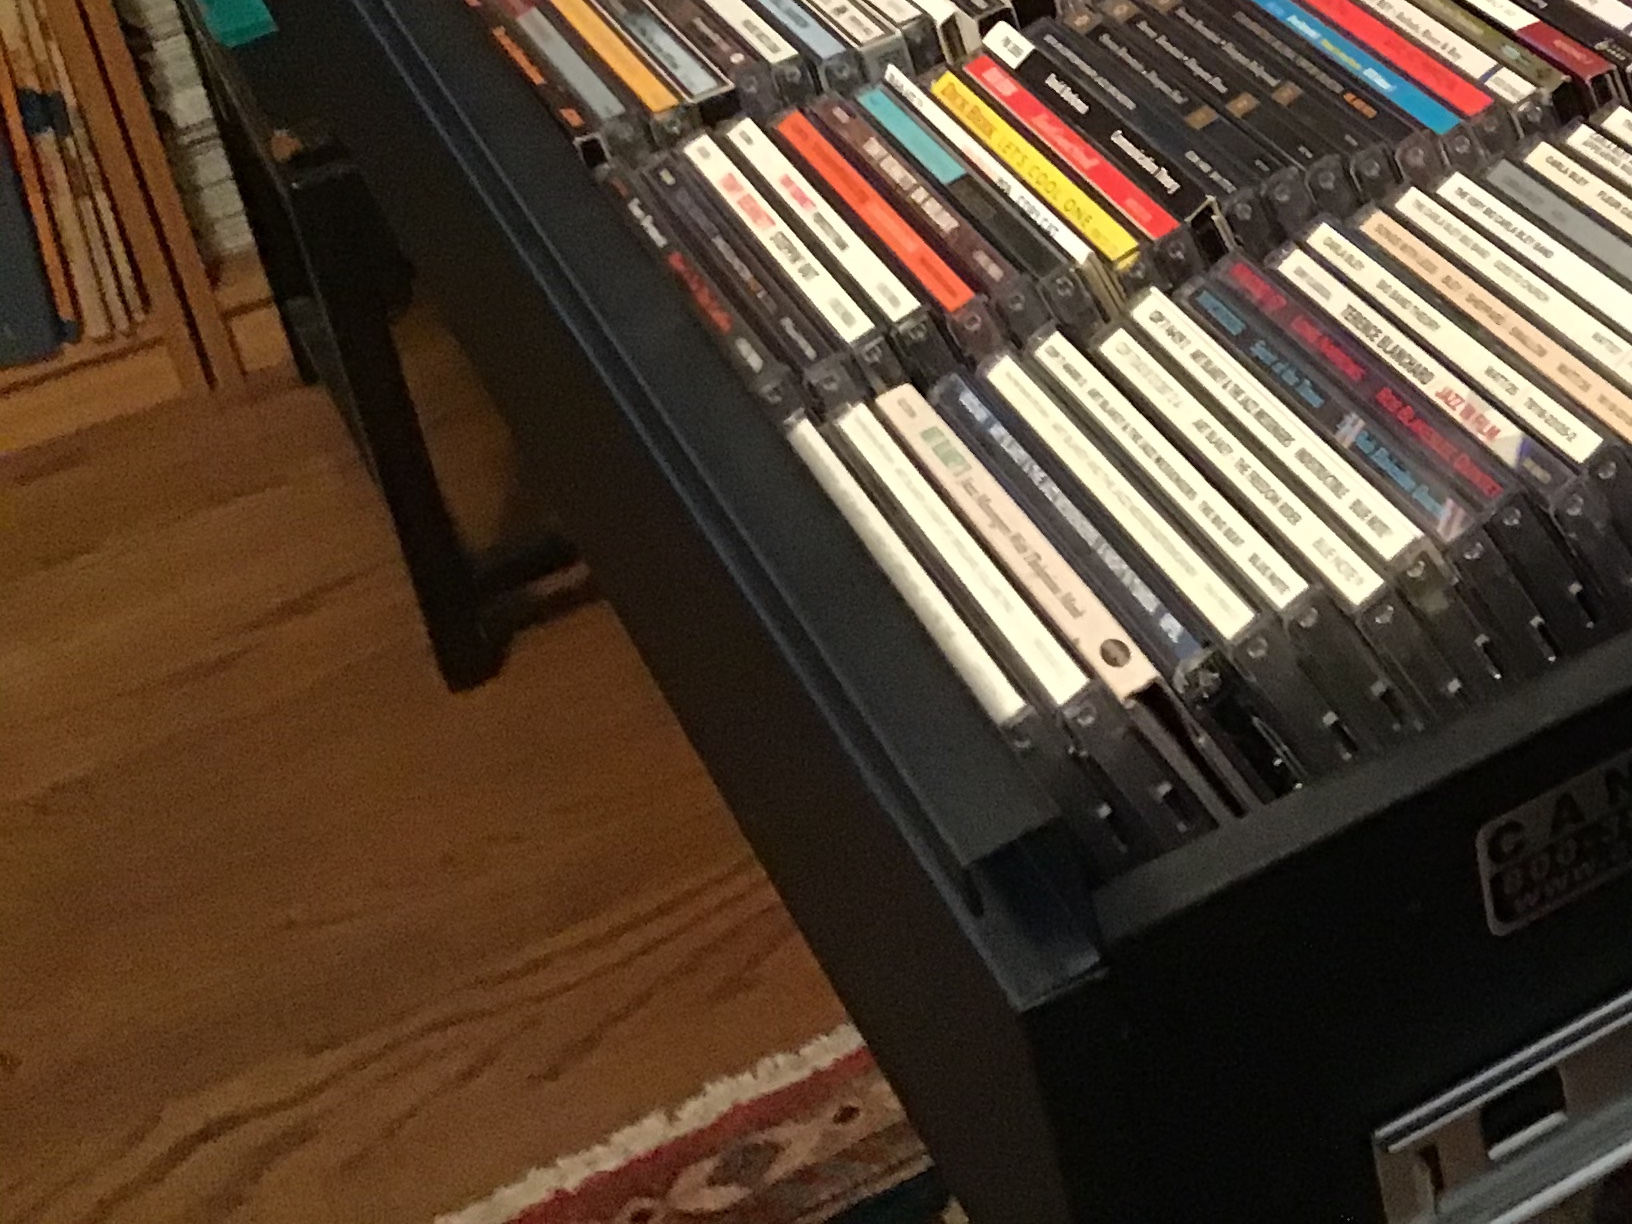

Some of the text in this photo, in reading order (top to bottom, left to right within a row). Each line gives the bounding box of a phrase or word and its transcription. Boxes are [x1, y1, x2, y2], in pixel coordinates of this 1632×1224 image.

[1024, 162, 1065, 201] COOL
[1060, 196, 1094, 229] ONE
[1338, 301, 1383, 343] TERENCE
[1374, 332, 1435, 387] BLANCHARD
[1433, 382, 1465, 413] JAZZ
[1468, 411, 1502, 443] FILM
